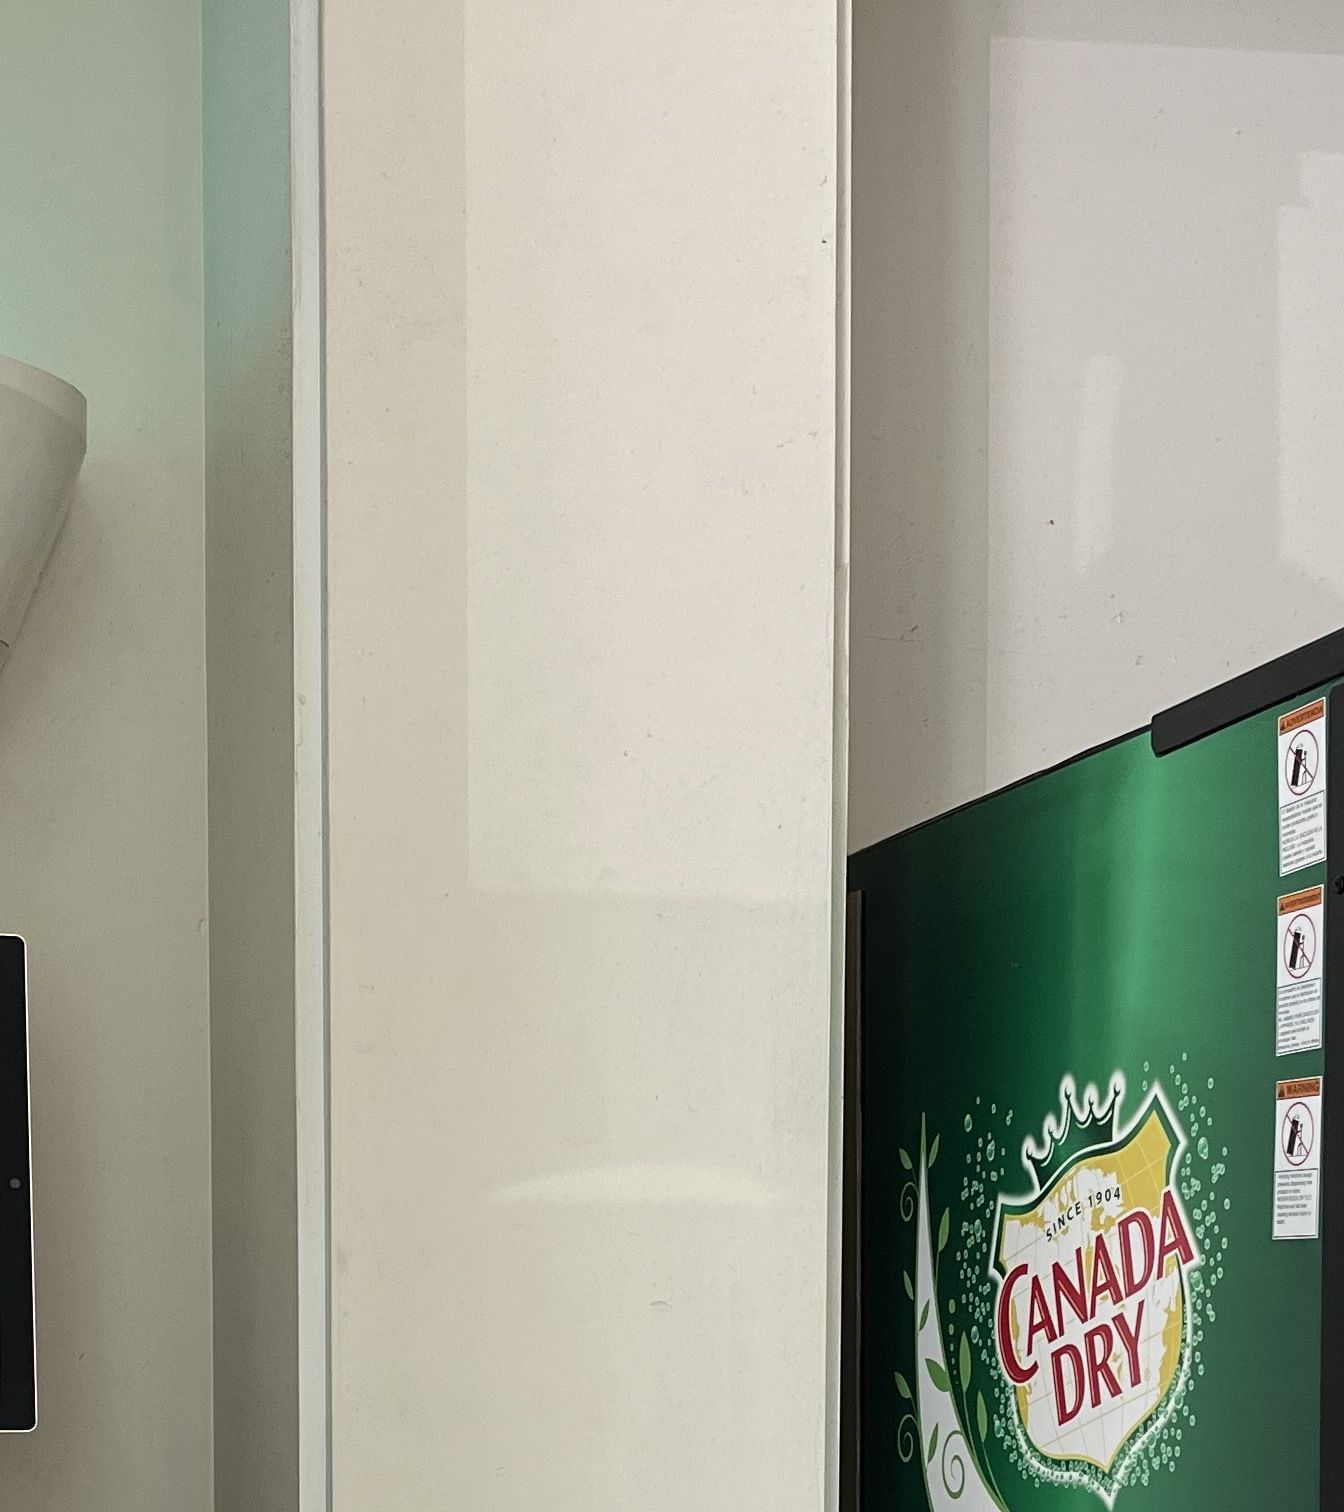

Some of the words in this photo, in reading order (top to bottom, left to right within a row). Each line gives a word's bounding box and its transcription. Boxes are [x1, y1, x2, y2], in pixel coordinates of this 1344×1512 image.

[1044, 1202, 1083, 1242] SINCE
[1087, 1185, 1122, 1210] 1904
[996, 1189, 1195, 1385] CANADA
[1050, 1299, 1145, 1427] DRY
